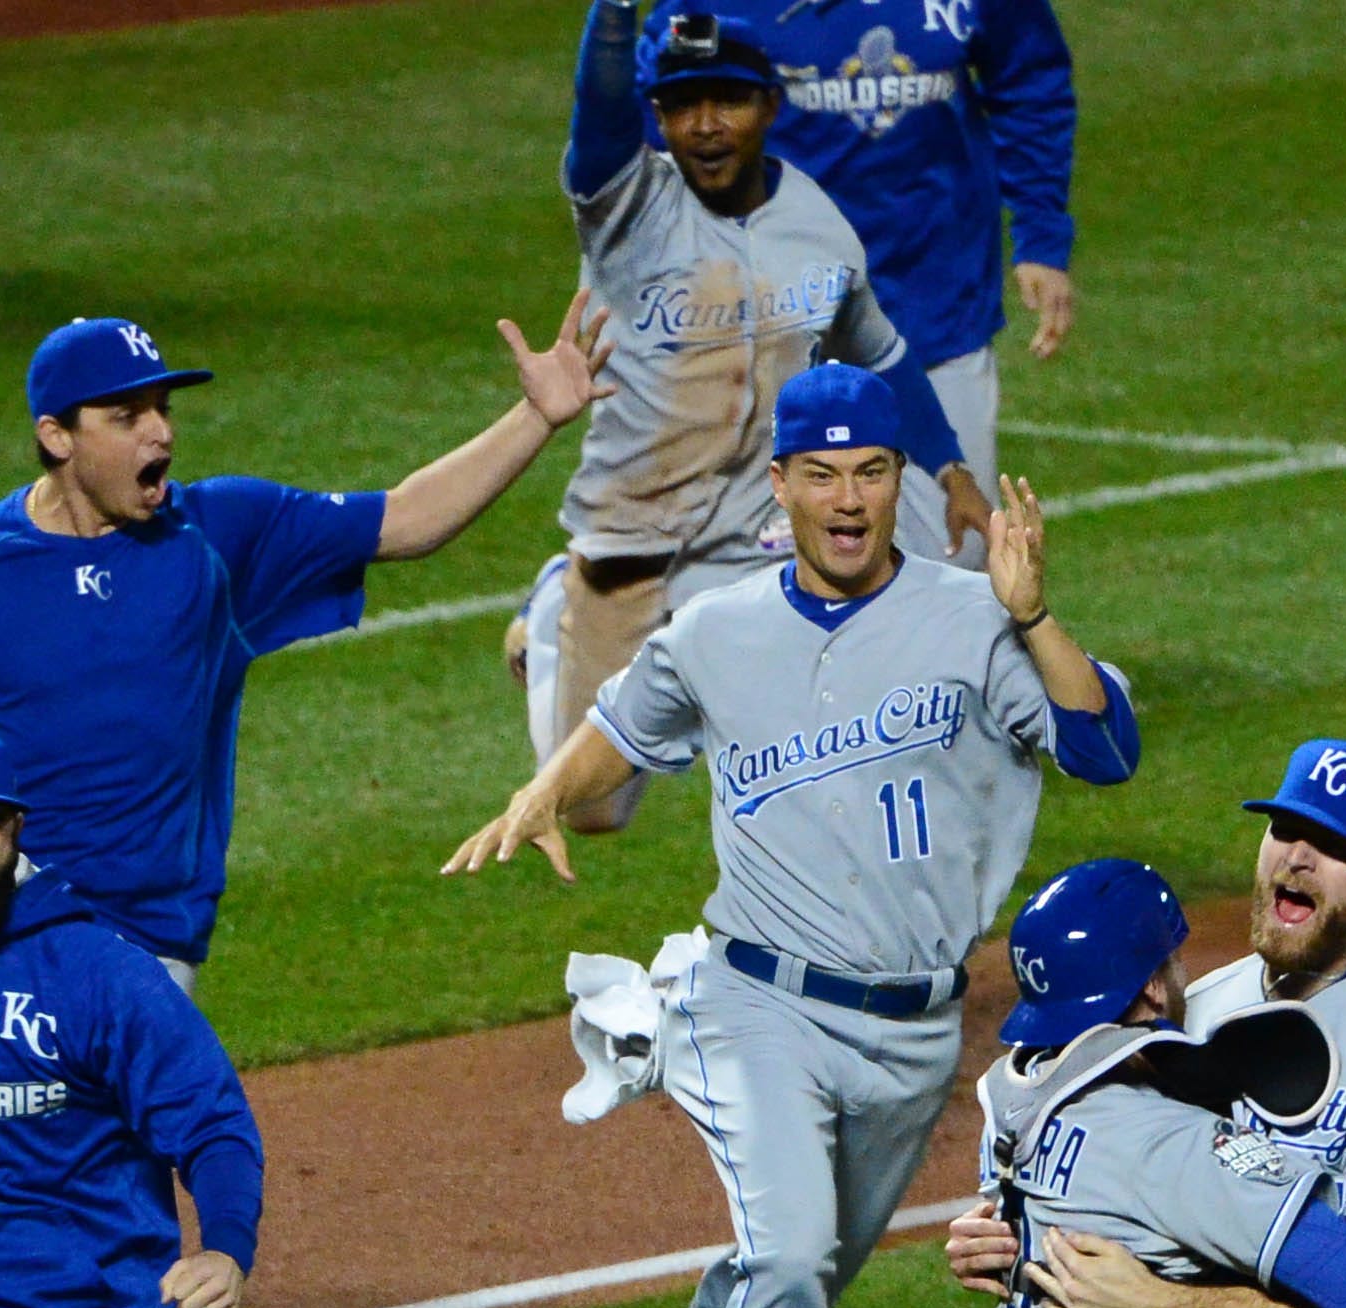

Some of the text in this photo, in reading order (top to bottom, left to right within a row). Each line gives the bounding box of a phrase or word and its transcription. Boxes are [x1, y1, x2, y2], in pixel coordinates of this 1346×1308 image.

[118, 324, 159, 361] KC
[75, 564, 113, 601] KC
[717, 684, 966, 807] Kansas City
[876, 775, 931, 863] 11
[1012, 945, 1050, 994] KC
[0, 991, 59, 1060] KC
